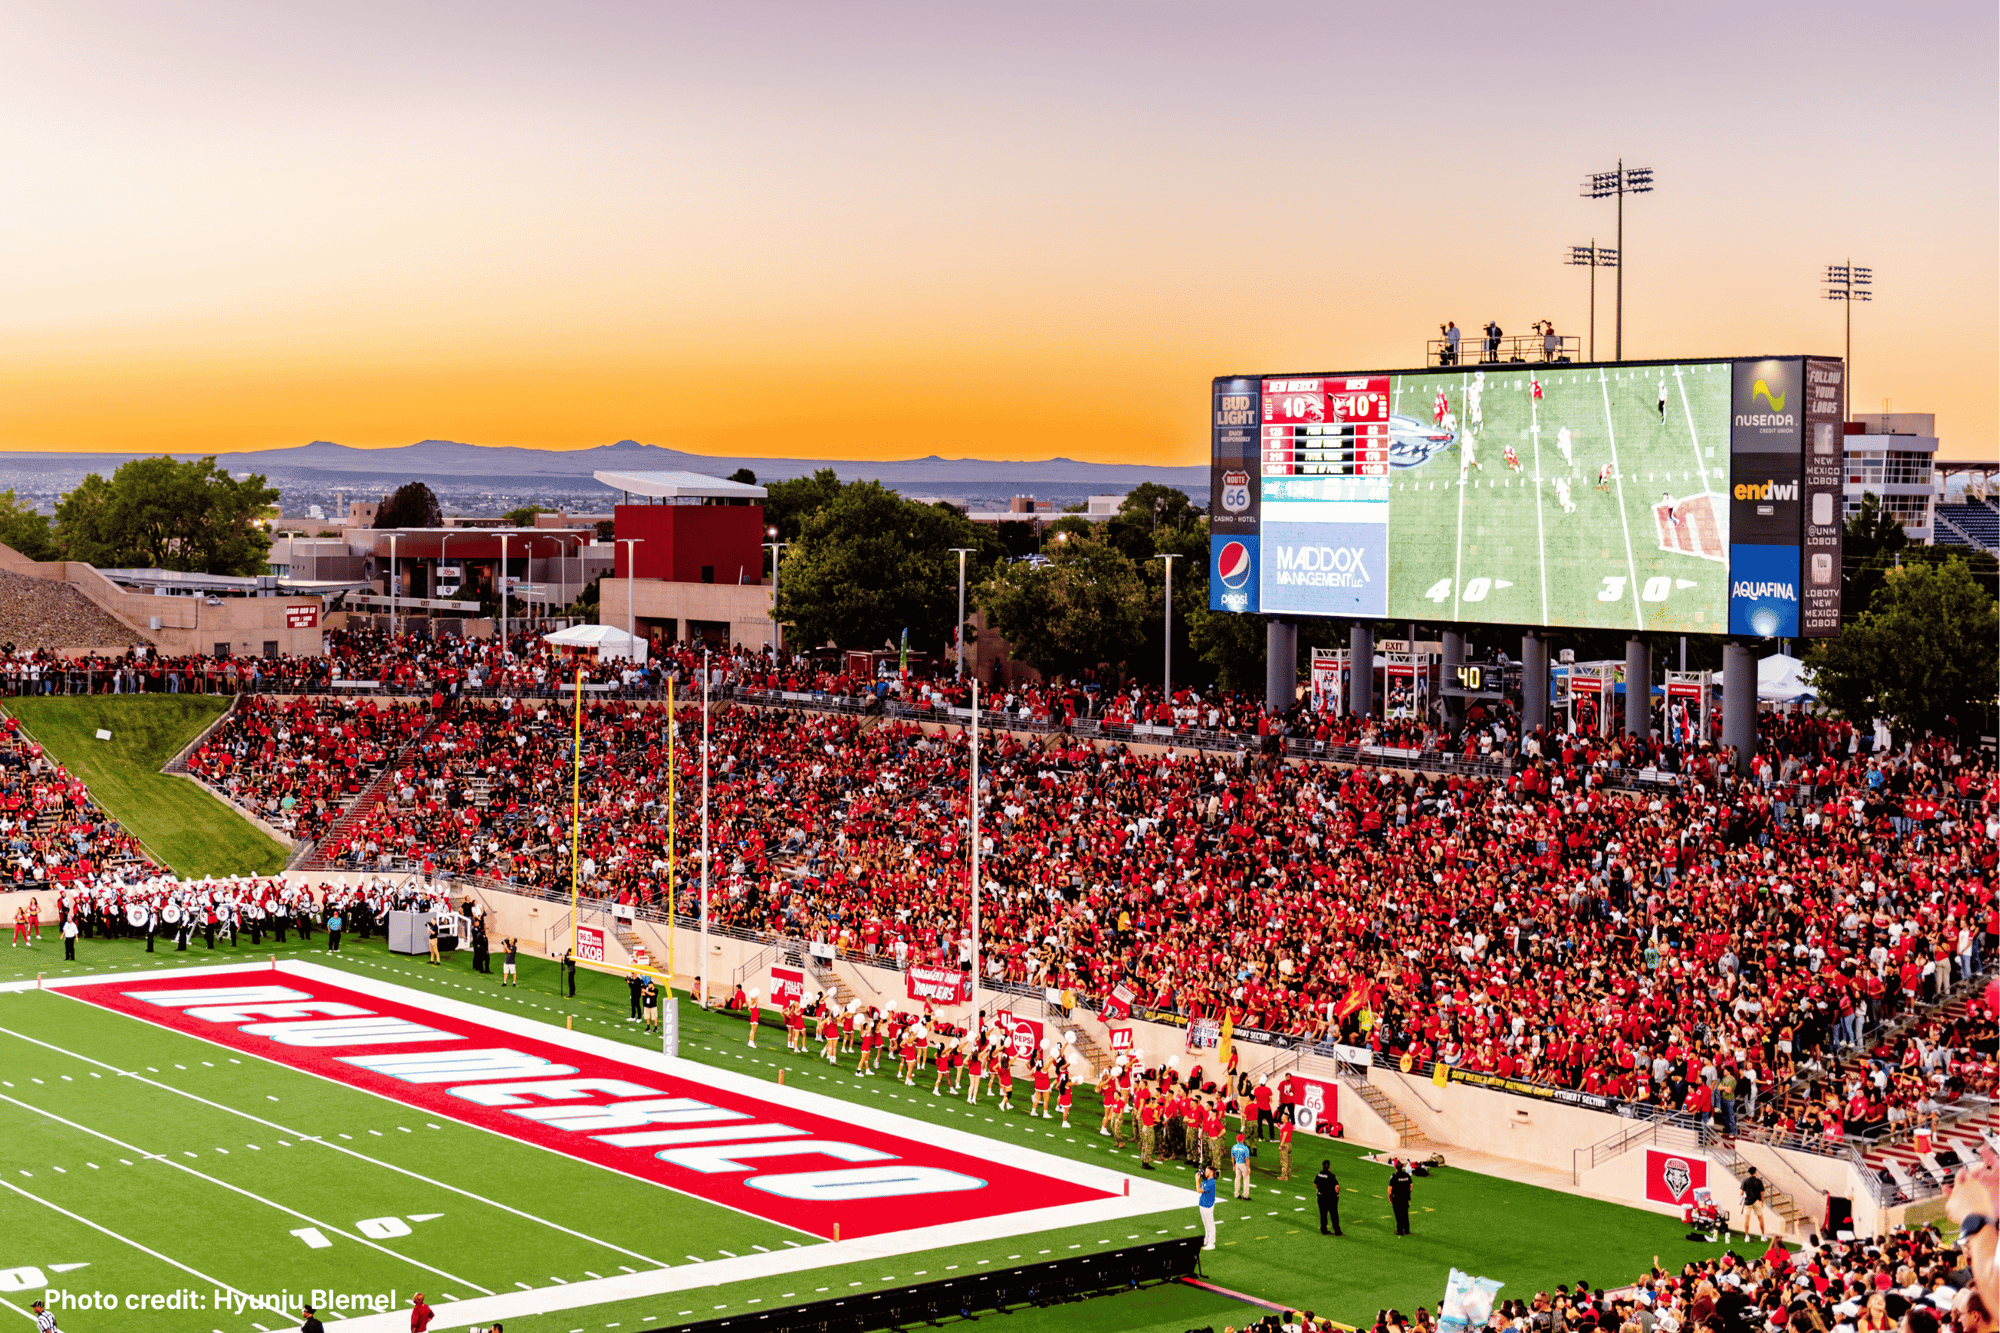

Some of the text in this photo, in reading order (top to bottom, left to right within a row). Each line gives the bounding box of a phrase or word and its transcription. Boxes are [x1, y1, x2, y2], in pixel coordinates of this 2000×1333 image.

[1809, 371, 1841, 384] FOLLOW
[1815, 386, 1836, 399] YOUR
[1222, 396, 1250, 411] BUD
[1283, 397, 1305, 418] 10
[1346, 395, 1370, 417] 10
[1811, 401, 1838, 414] LOBOS
[1216, 410, 1255, 425] LIGHT
[1735, 414, 1795, 427] NUSENDA
[1806, 467, 1840, 475] MEXICO
[1226, 475, 1246, 484] ROUTE
[1808, 477, 1838, 485] LOBOS
[1734, 479, 1798, 501] endwi
[1226, 489, 1246, 506] 66
[1808, 525, 1836, 537] @UNM
[1807, 537, 1837, 546] LOBOS
[1277, 546, 1371, 583] MADDOX
[1277, 571, 1364, 588] MANAGEMENT LLC
[1732, 581, 1797, 601] AQUAFINA
[1805, 589, 1839, 597] LOBOTV
[1221, 592, 1248, 606] pepsi
[1805, 609, 1838, 617] MEXICO
[1806, 619, 1837, 628] LOBOS
[1385, 641, 1403, 651] EXIT
[1457, 666, 1480, 689] 40
[580, 932, 591, 942] 96.3
[578, 944, 603, 961] KKOB
[665, 1002, 674, 1057] LOBOS
[1014, 1034, 1034, 1044] PEPSI
[119, 985, 989, 1201] NEW MEXICO
[1307, 1097, 1322, 1110] 66
[289, 1216, 412, 1249] 10
